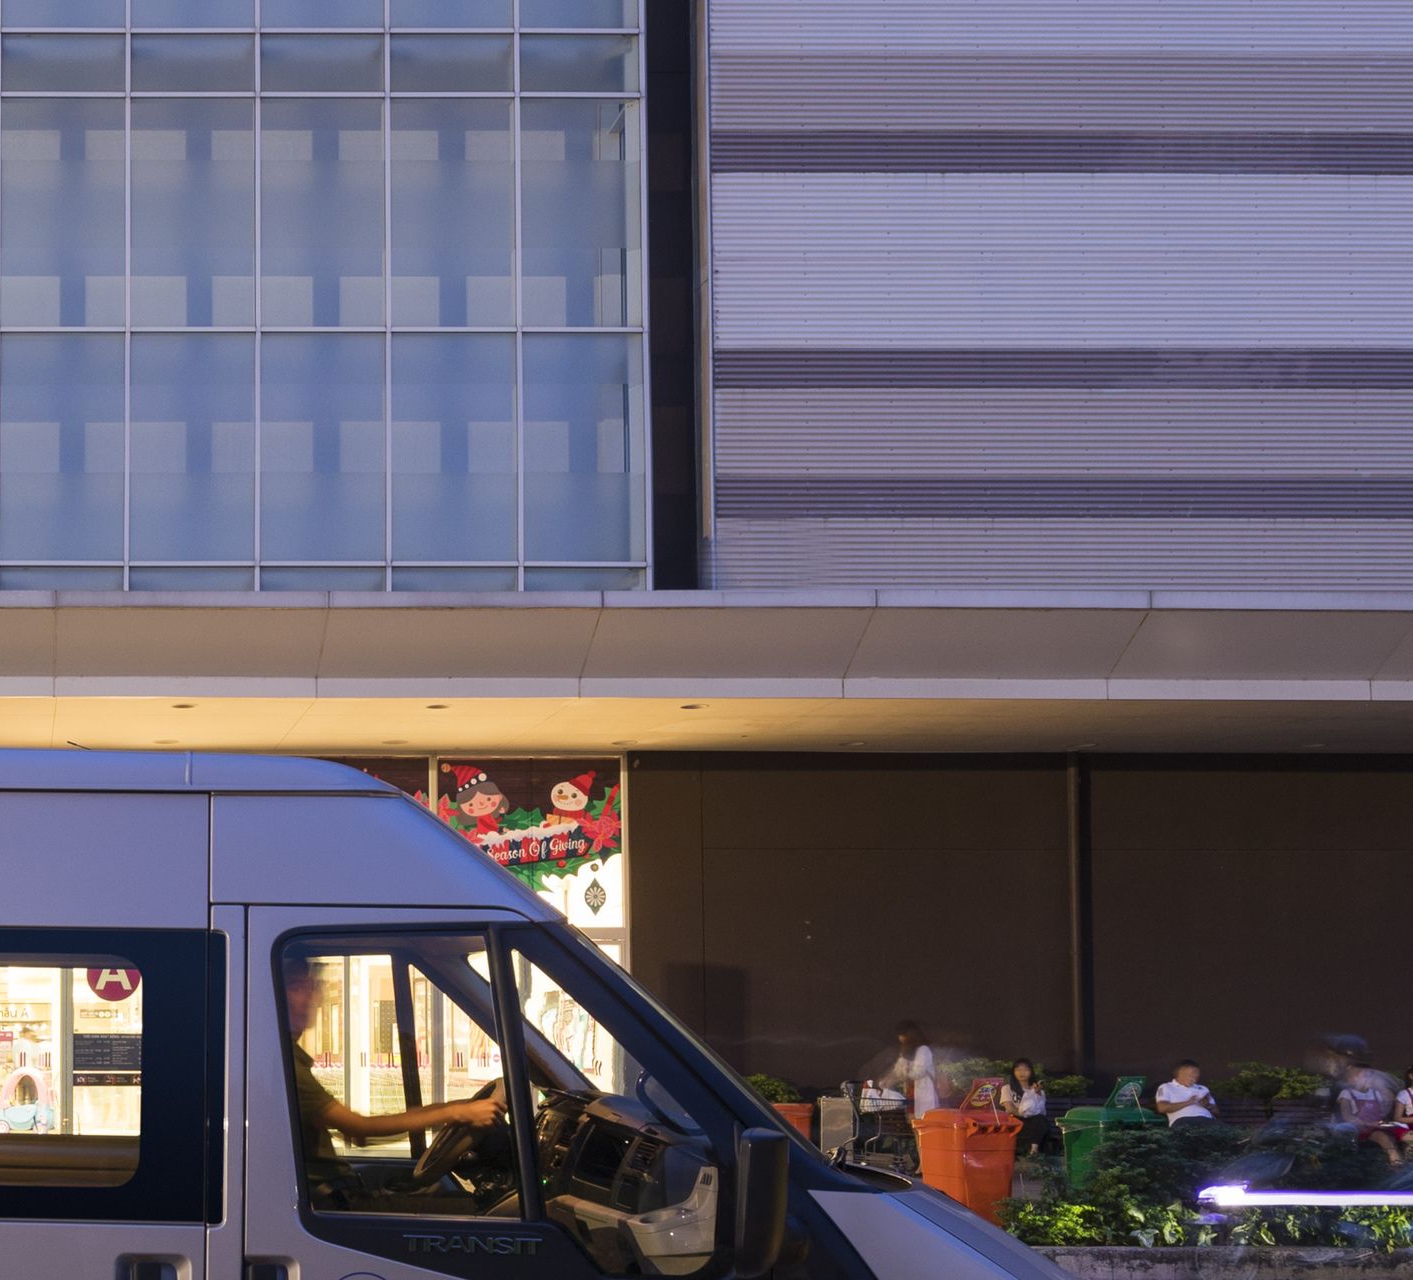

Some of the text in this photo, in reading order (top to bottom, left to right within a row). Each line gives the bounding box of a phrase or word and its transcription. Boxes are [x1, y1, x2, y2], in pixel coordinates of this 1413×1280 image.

[529, 840, 547, 859] Of
[549, 838, 586, 856] Giving
[402, 1234, 543, 1255] TRANSIT
